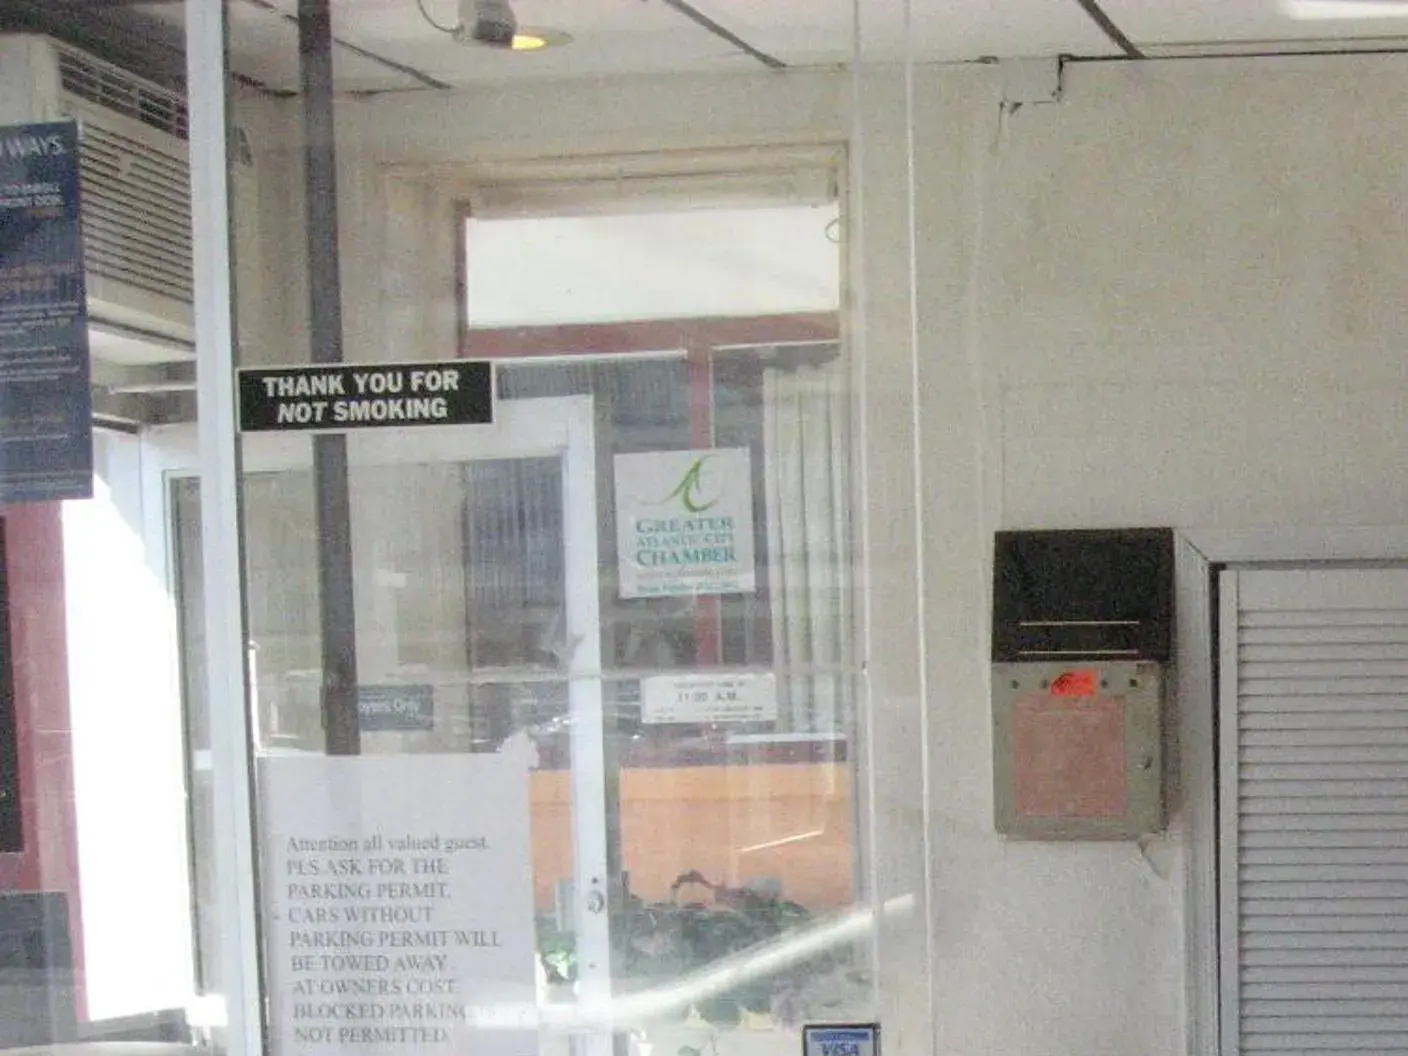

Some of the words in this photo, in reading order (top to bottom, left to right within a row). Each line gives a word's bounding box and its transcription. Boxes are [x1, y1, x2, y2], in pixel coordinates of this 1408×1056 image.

[262, 374, 345, 398] THANK
[352, 371, 402, 394] YOU
[410, 369, 459, 392] FOR
[277, 402, 328, 424] NOT
[333, 398, 449, 422] SMOKING
[636, 517, 735, 534] GREATER
[636, 547, 737, 567] CHAMBER
[286, 836, 358, 852] Attention
[363, 834, 383, 851] all
[387, 833, 440, 851] valued
[327, 857, 362, 877] ASK
[368, 858, 407, 876] FOR
[411, 857, 450, 875] THE
[287, 882, 371, 900] PARKING
[288, 906, 339, 924] CARS
[344, 905, 434, 923] WITHOUT
[289, 930, 374, 948] PARKING
[378, 929, 449, 948] PERMIT
[453, 929, 502, 948] WILL
[291, 954, 315, 972] BE
[320, 954, 390, 972] TOWED
[292, 979, 316, 996] AT
[320, 978, 402, 996] OWNERS
[293, 1003, 385, 1020] BLOCKED
[294, 1026, 333, 1045] NOT
[338, 1026, 448, 1044] PERMITTED
